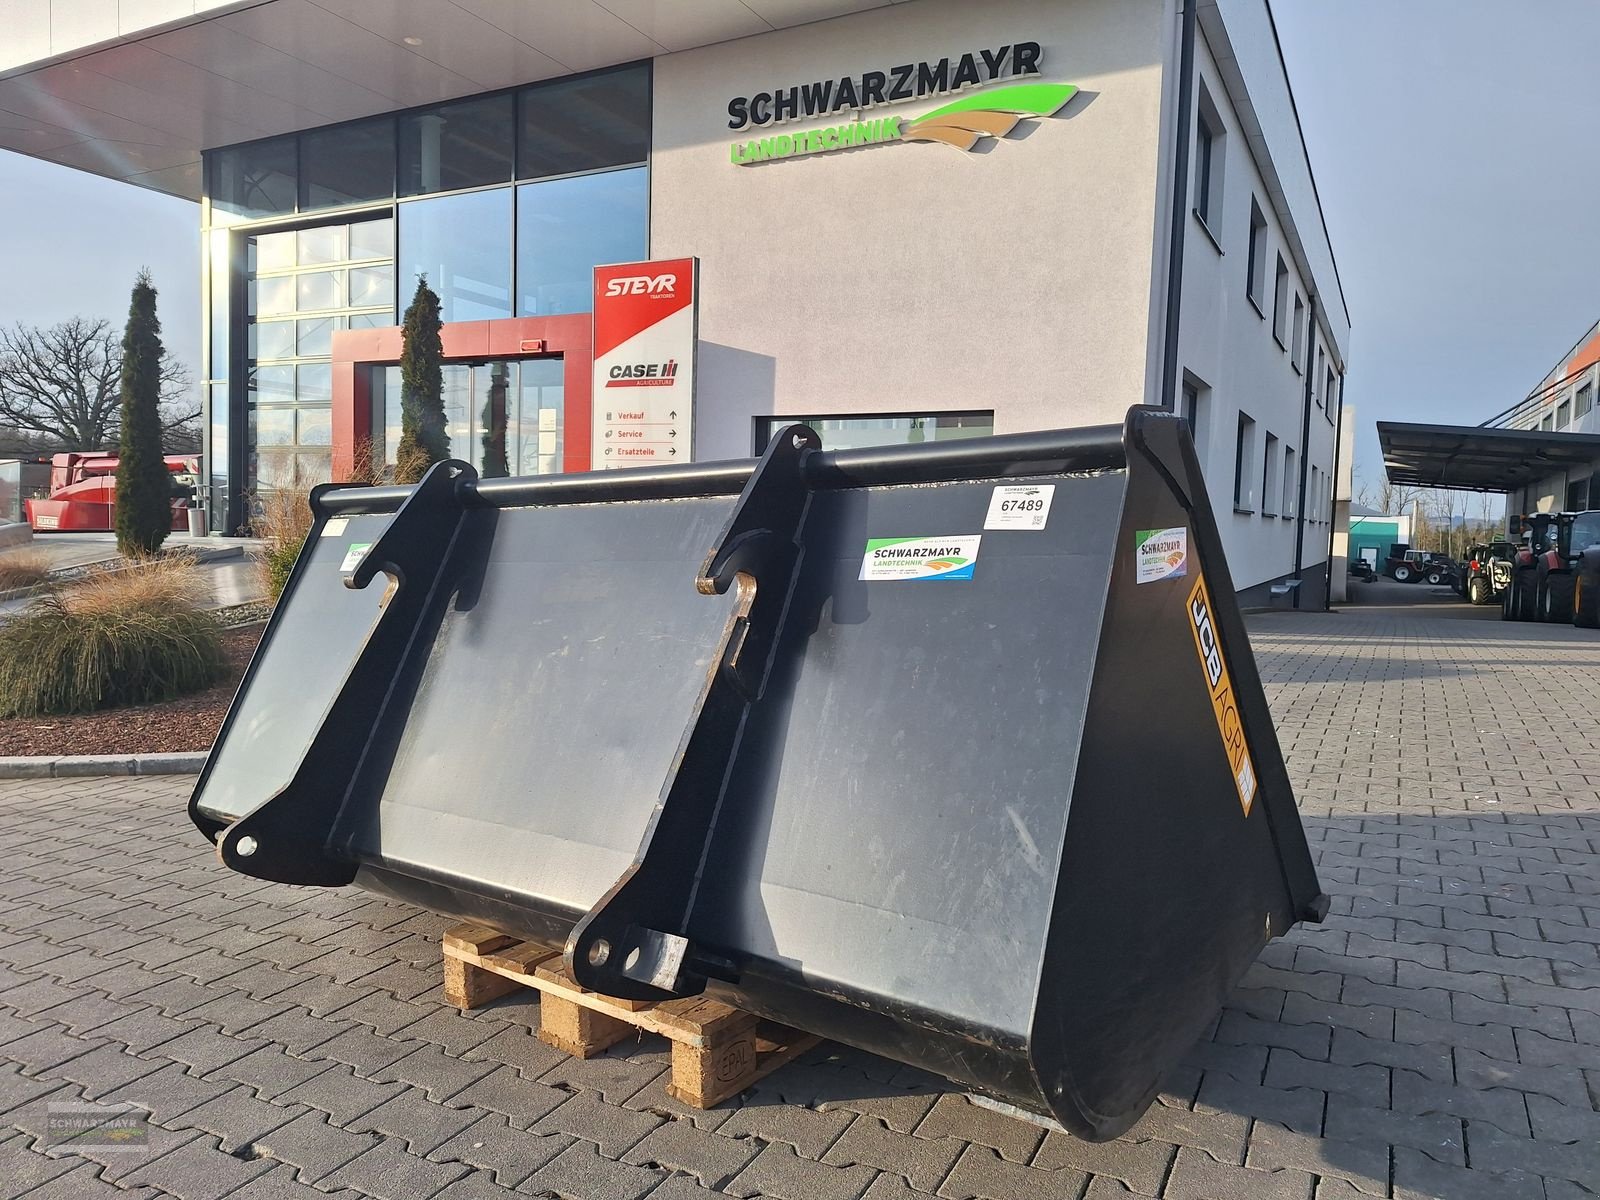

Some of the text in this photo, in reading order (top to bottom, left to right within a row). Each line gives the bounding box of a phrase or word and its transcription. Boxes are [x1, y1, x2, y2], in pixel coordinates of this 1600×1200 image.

[728, 41, 1042, 131] SCHWARZMAYR
[730, 116, 902, 164] LANDTECHNIK
[605, 274, 677, 297] STEYR
[609, 364, 658, 378] CASE
[618, 412, 644, 420] Verkauf
[617, 447, 655, 456] Ersatzteile
[1001, 499, 1043, 511] 67489
[873, 547, 961, 559] SCHWARZMAYR
[1141, 540, 1180, 555] SCHWARZMAYR
[1191, 599, 1245, 771] JCB AGRI
[722, 1046, 749, 1077] EPAL
